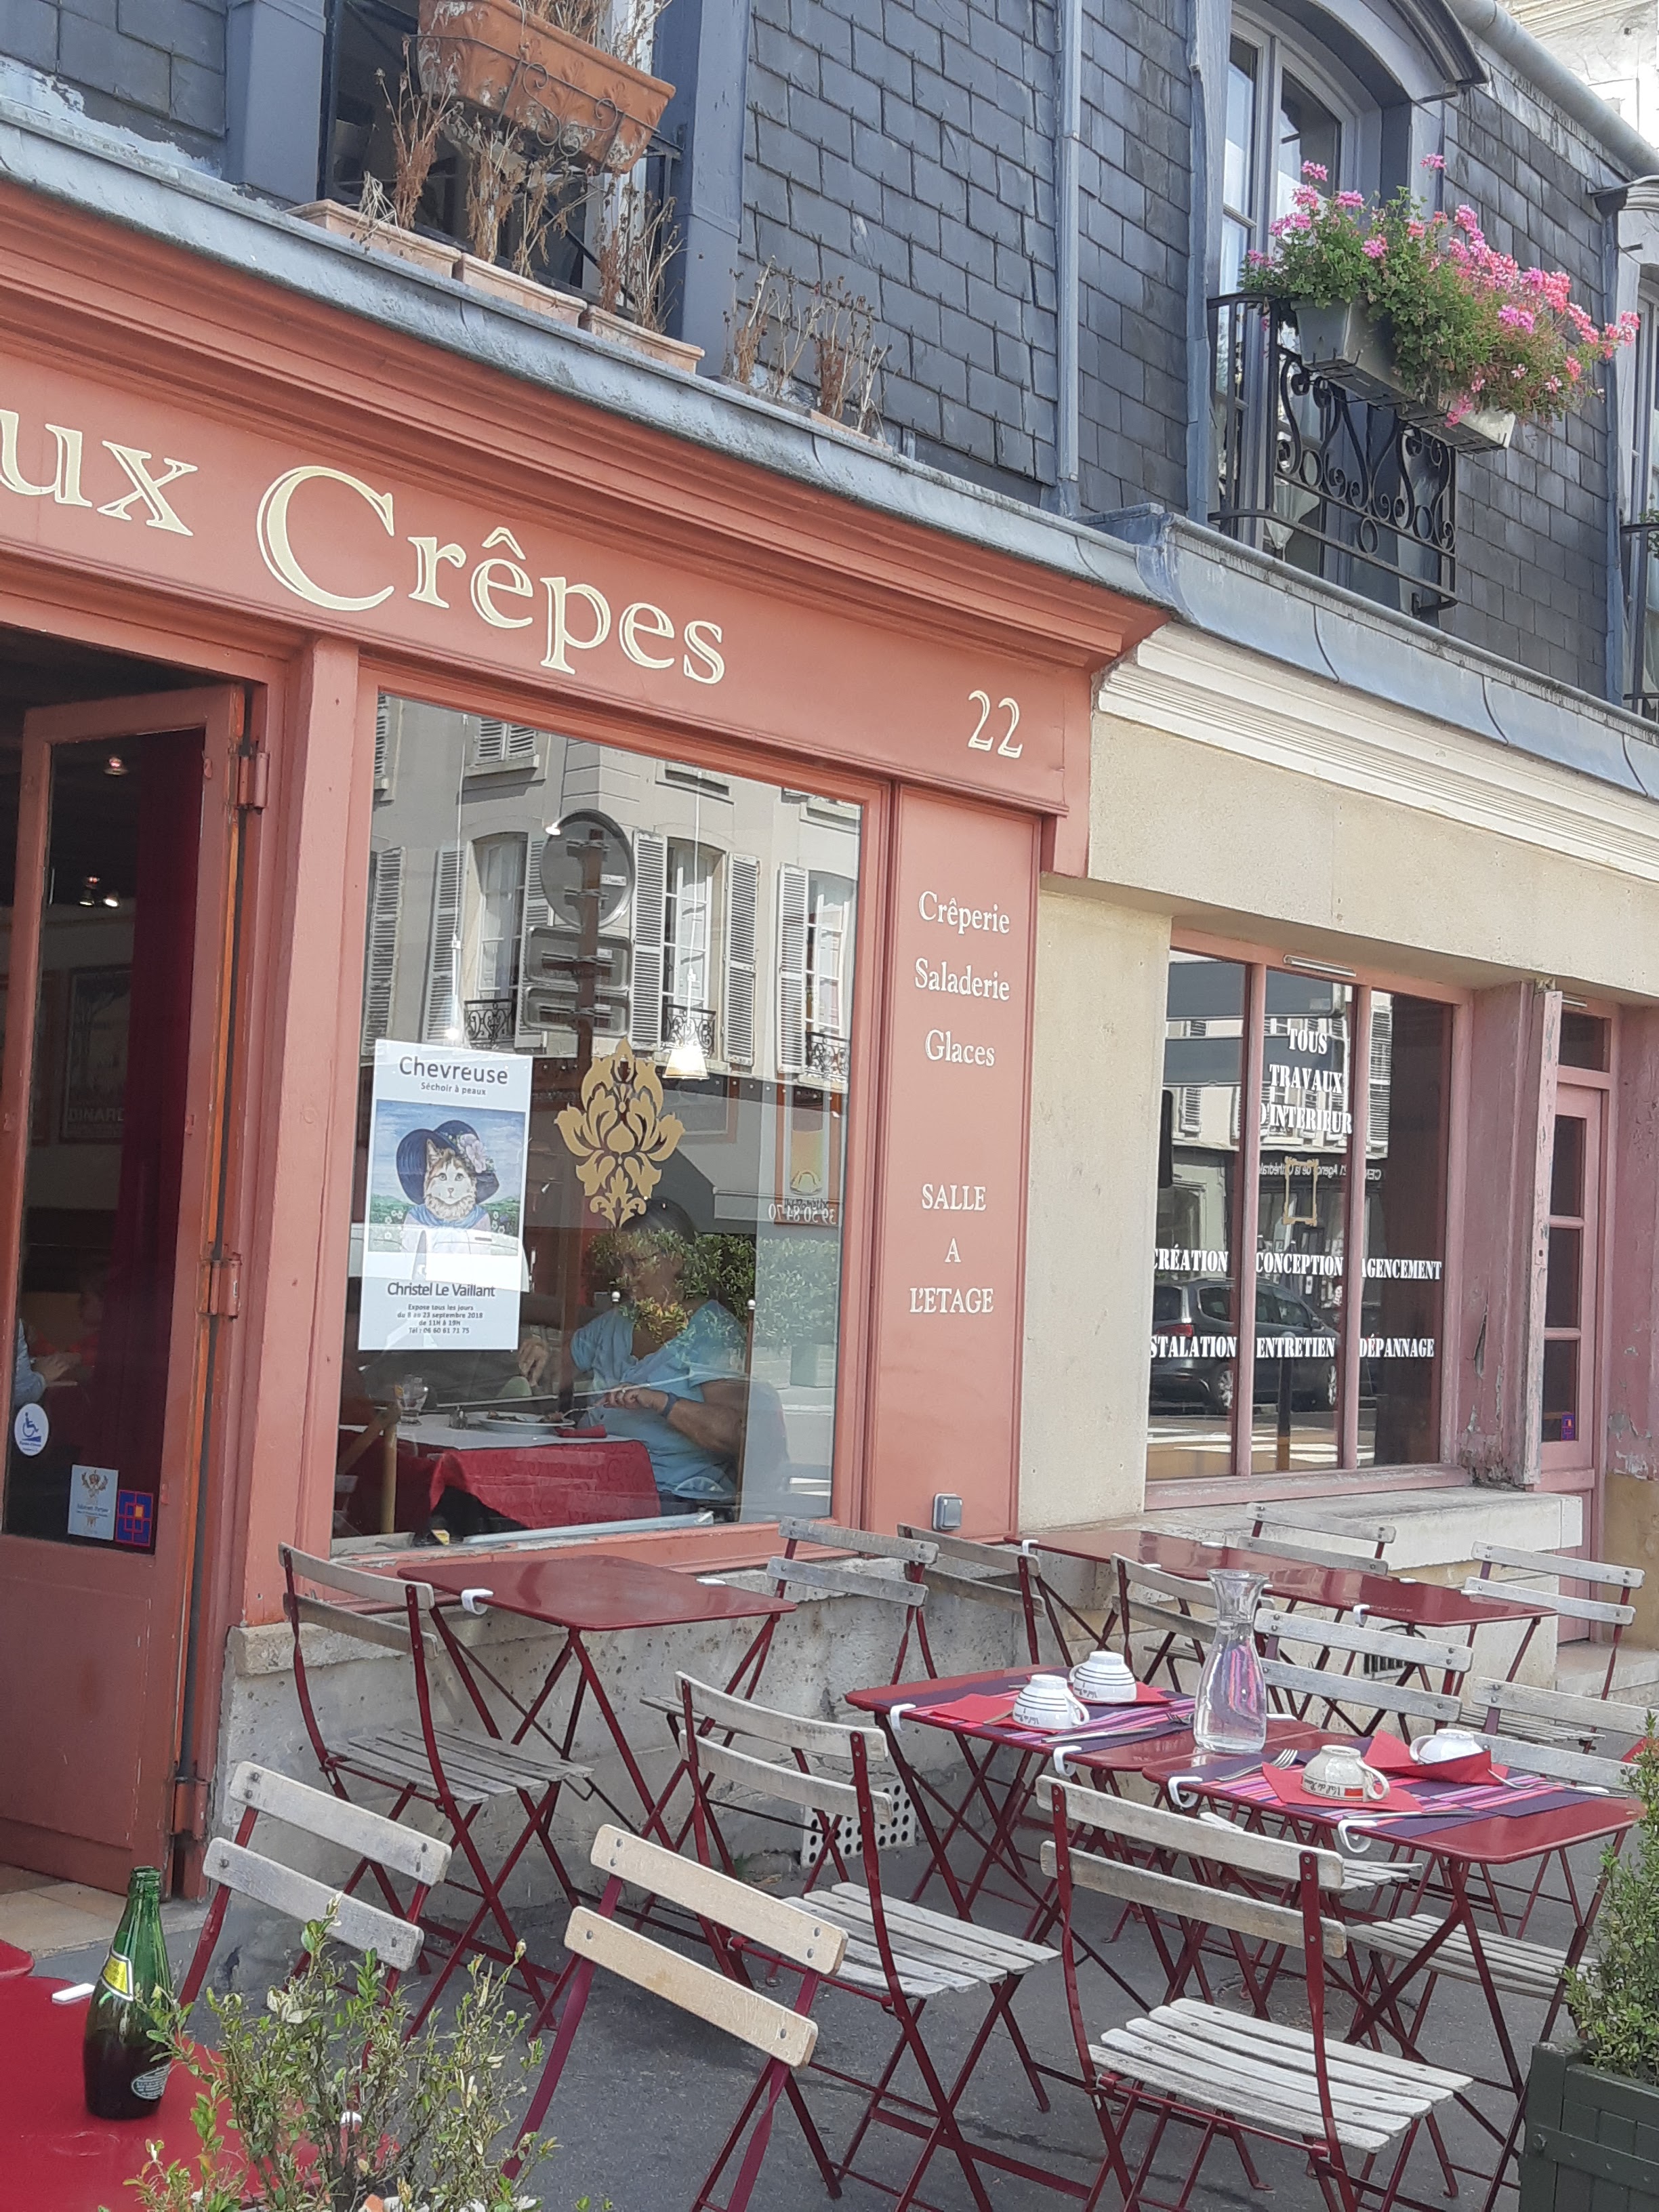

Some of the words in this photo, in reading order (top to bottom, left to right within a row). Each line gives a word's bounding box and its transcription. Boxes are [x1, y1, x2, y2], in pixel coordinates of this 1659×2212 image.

[0, 409, 199, 537] ux
[257, 464, 725, 685] Crêpes
[968, 690, 1023, 759] 22
[918, 890, 1010, 934] Crêperie
[916, 958, 1010, 1001] Saladerie
[925, 1029, 996, 1067] Glaces
[1288, 1028, 1328, 1054] TOUS
[399, 1056, 508, 1084] Chevreuse
[1269, 1064, 1343, 1094] TRAVAUX
[421, 1082, 453, 1092] Séchoir
[455, 1084, 459, 1092] à
[462, 1087, 487, 1095] peaux
[922, 1183, 987, 1211] SALLE
[945, 1237, 962, 1263] A
[1256, 1252, 1344, 1276] CONCEPTION
[387, 1282, 432, 1296] Christel
[435, 1284, 449, 1296] Le
[452, 1284, 495, 1297] Vaillant
[909, 1287, 994, 1313] L'ETAGE
[1256, 1337, 1336, 1358] ENTRETIEN
[1359, 1333, 1435, 1357] DÉPANNAGE
